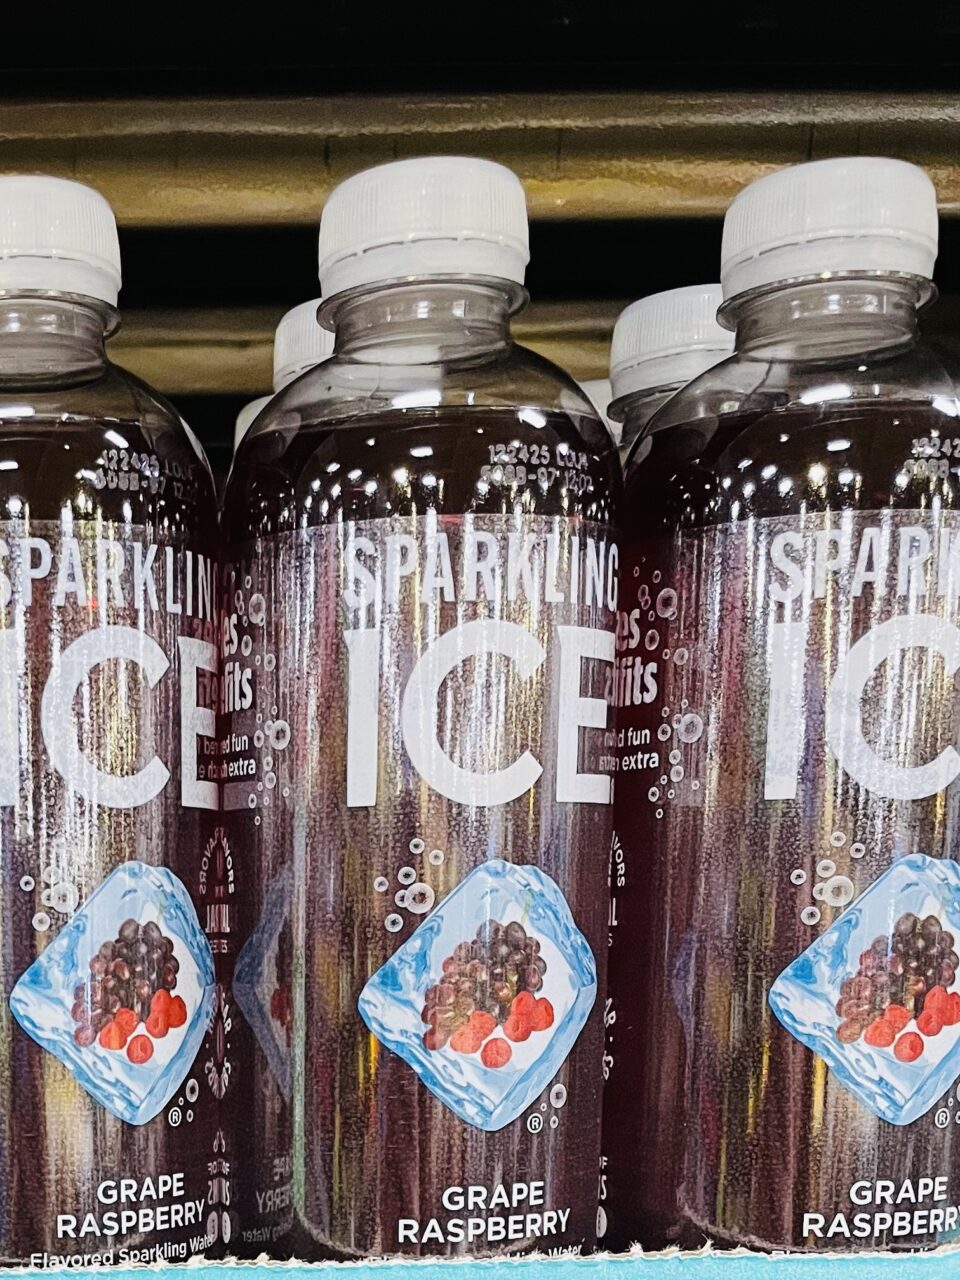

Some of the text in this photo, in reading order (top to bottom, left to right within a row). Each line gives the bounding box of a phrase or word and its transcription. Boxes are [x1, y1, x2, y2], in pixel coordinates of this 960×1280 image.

[343, 531, 620, 610] SPARKLING
[343, 619, 617, 808] ICE
[97, 1173, 185, 1204] GRAPE
[442, 1181, 544, 1211] GRAPE
[850, 1176, 948, 1205] GRAPE
[57, 1199, 205, 1239] RASPBERRY
[398, 1208, 571, 1244] RASPBERRY
[802, 1205, 960, 1238] RASPBERR
